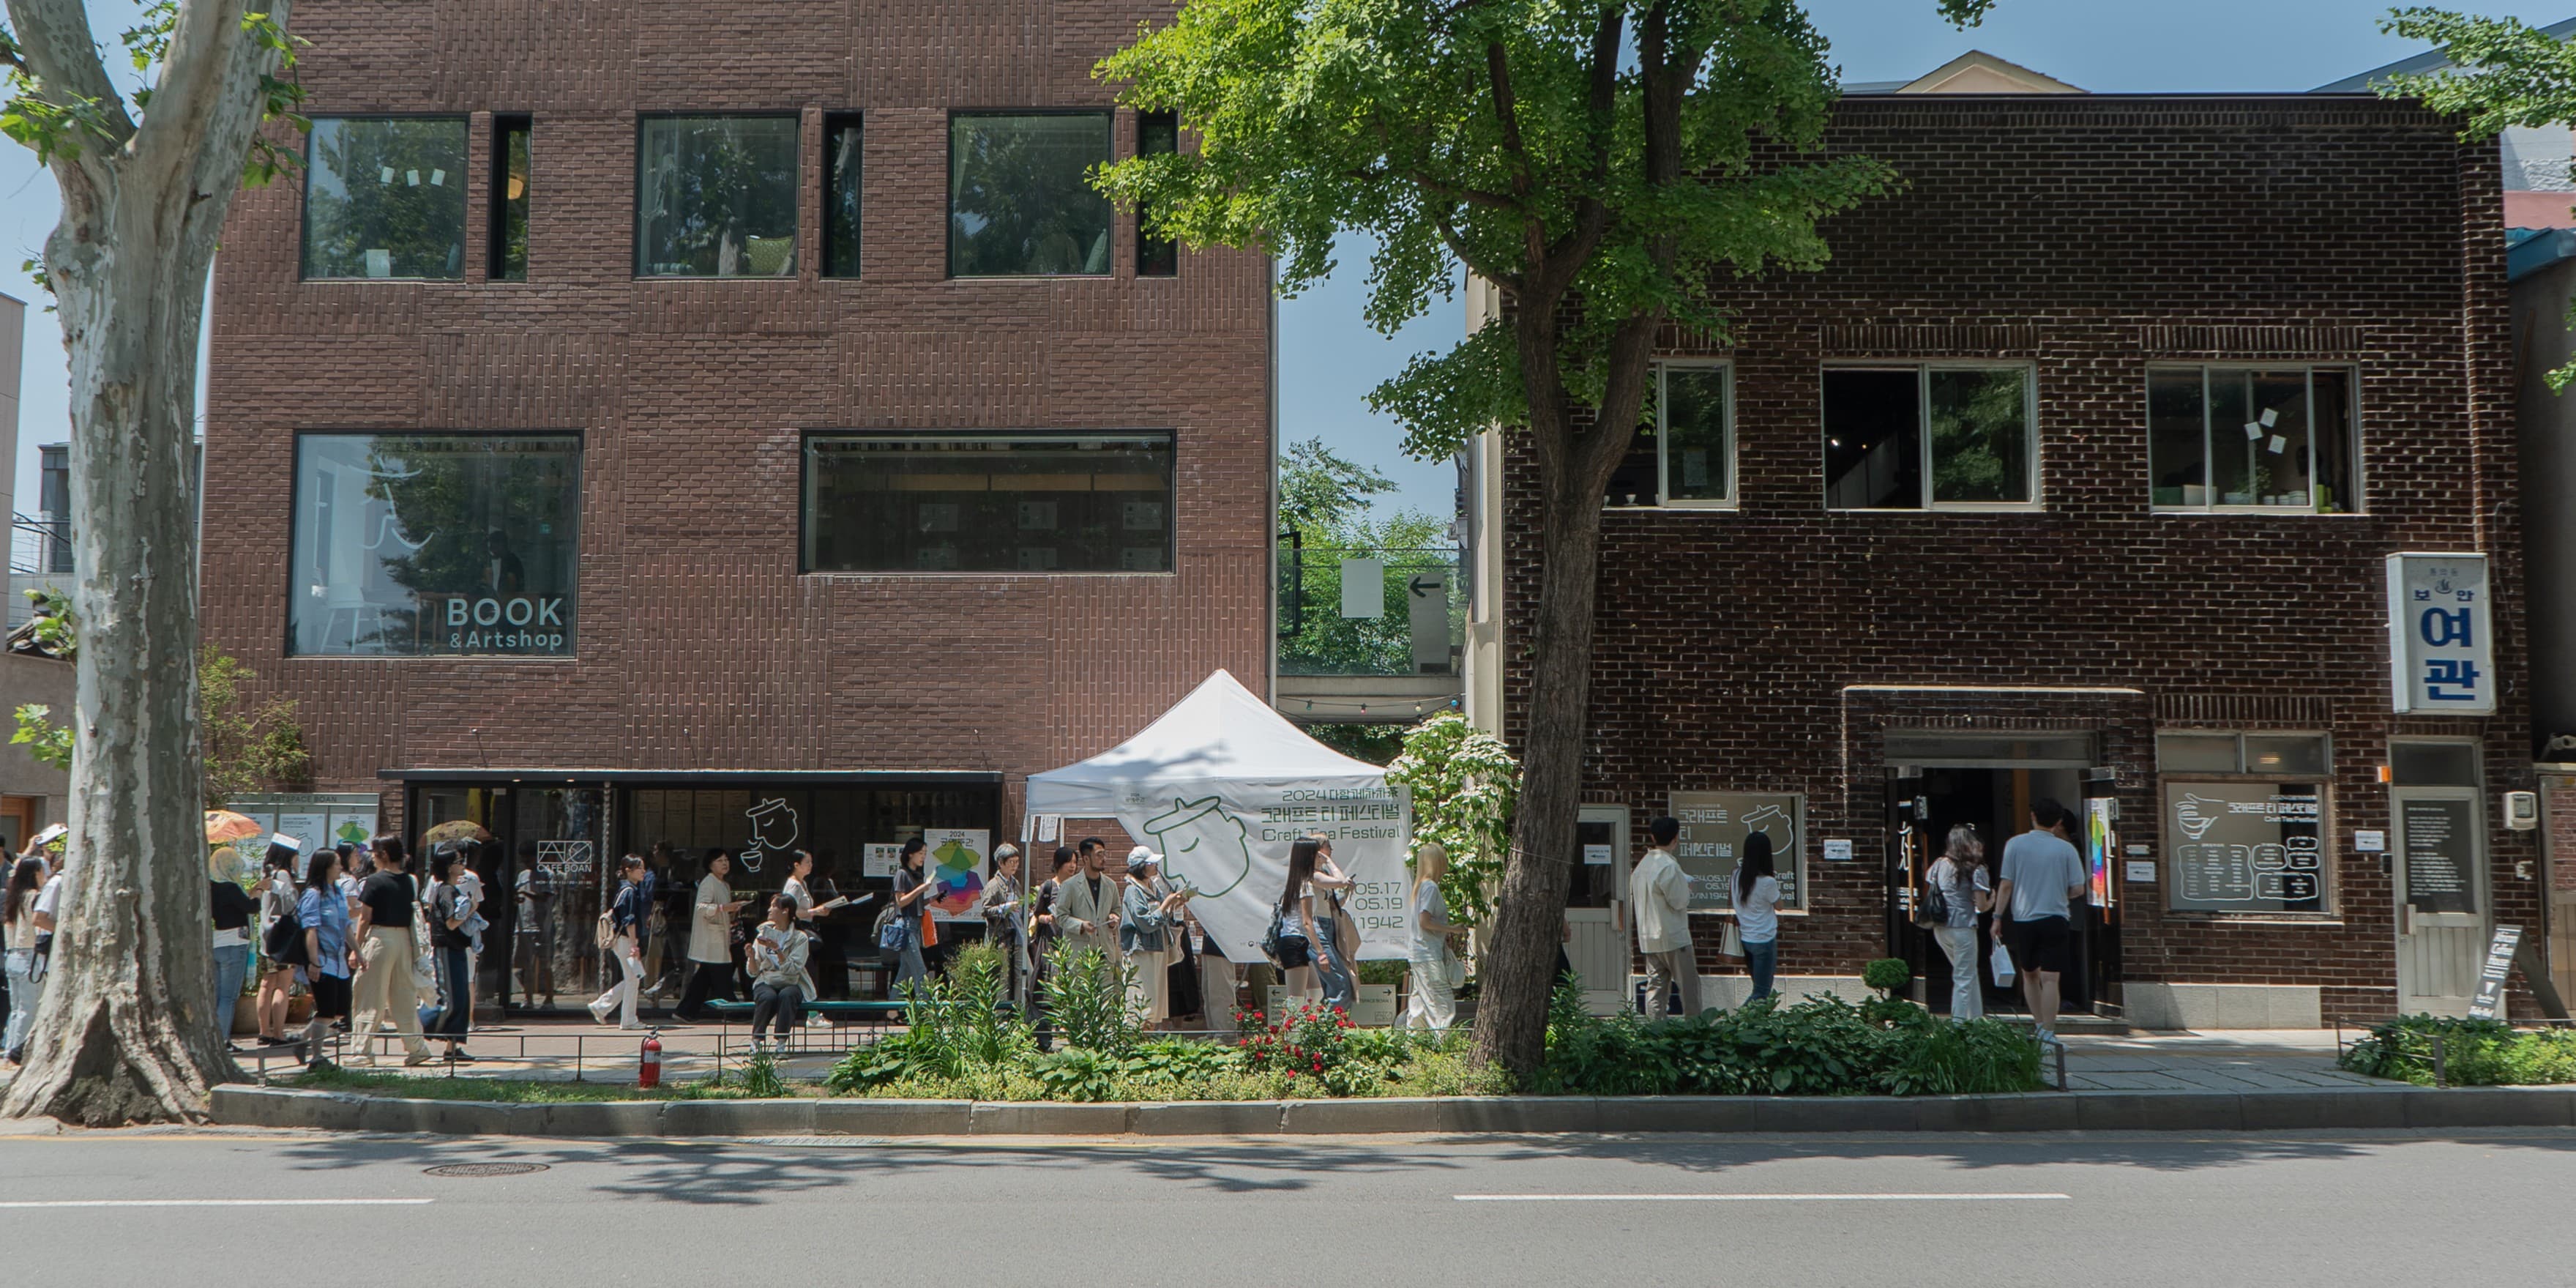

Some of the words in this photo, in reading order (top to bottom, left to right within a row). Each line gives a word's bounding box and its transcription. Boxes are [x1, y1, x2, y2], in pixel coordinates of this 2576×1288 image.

[447, 598, 562, 626] BOOK
[450, 630, 563, 651] &Artshop
[1283, 789, 1326, 801] 2024
[1261, 806, 1317, 823] 크래프트
[1321, 806, 1334, 822] 티
[1340, 805, 1399, 821] 페스티벌
[1679, 810, 1728, 824] 크래프트
[1262, 828, 1302, 841] Craft
[1340, 825, 1400, 839] Festival
[1679, 826, 1691, 840] 티
[537, 864, 562, 872] CAFE
[564, 864, 592, 873] BOAN
[1355, 898, 1403, 910] 05.19
[1360, 916, 1404, 928] 1942
